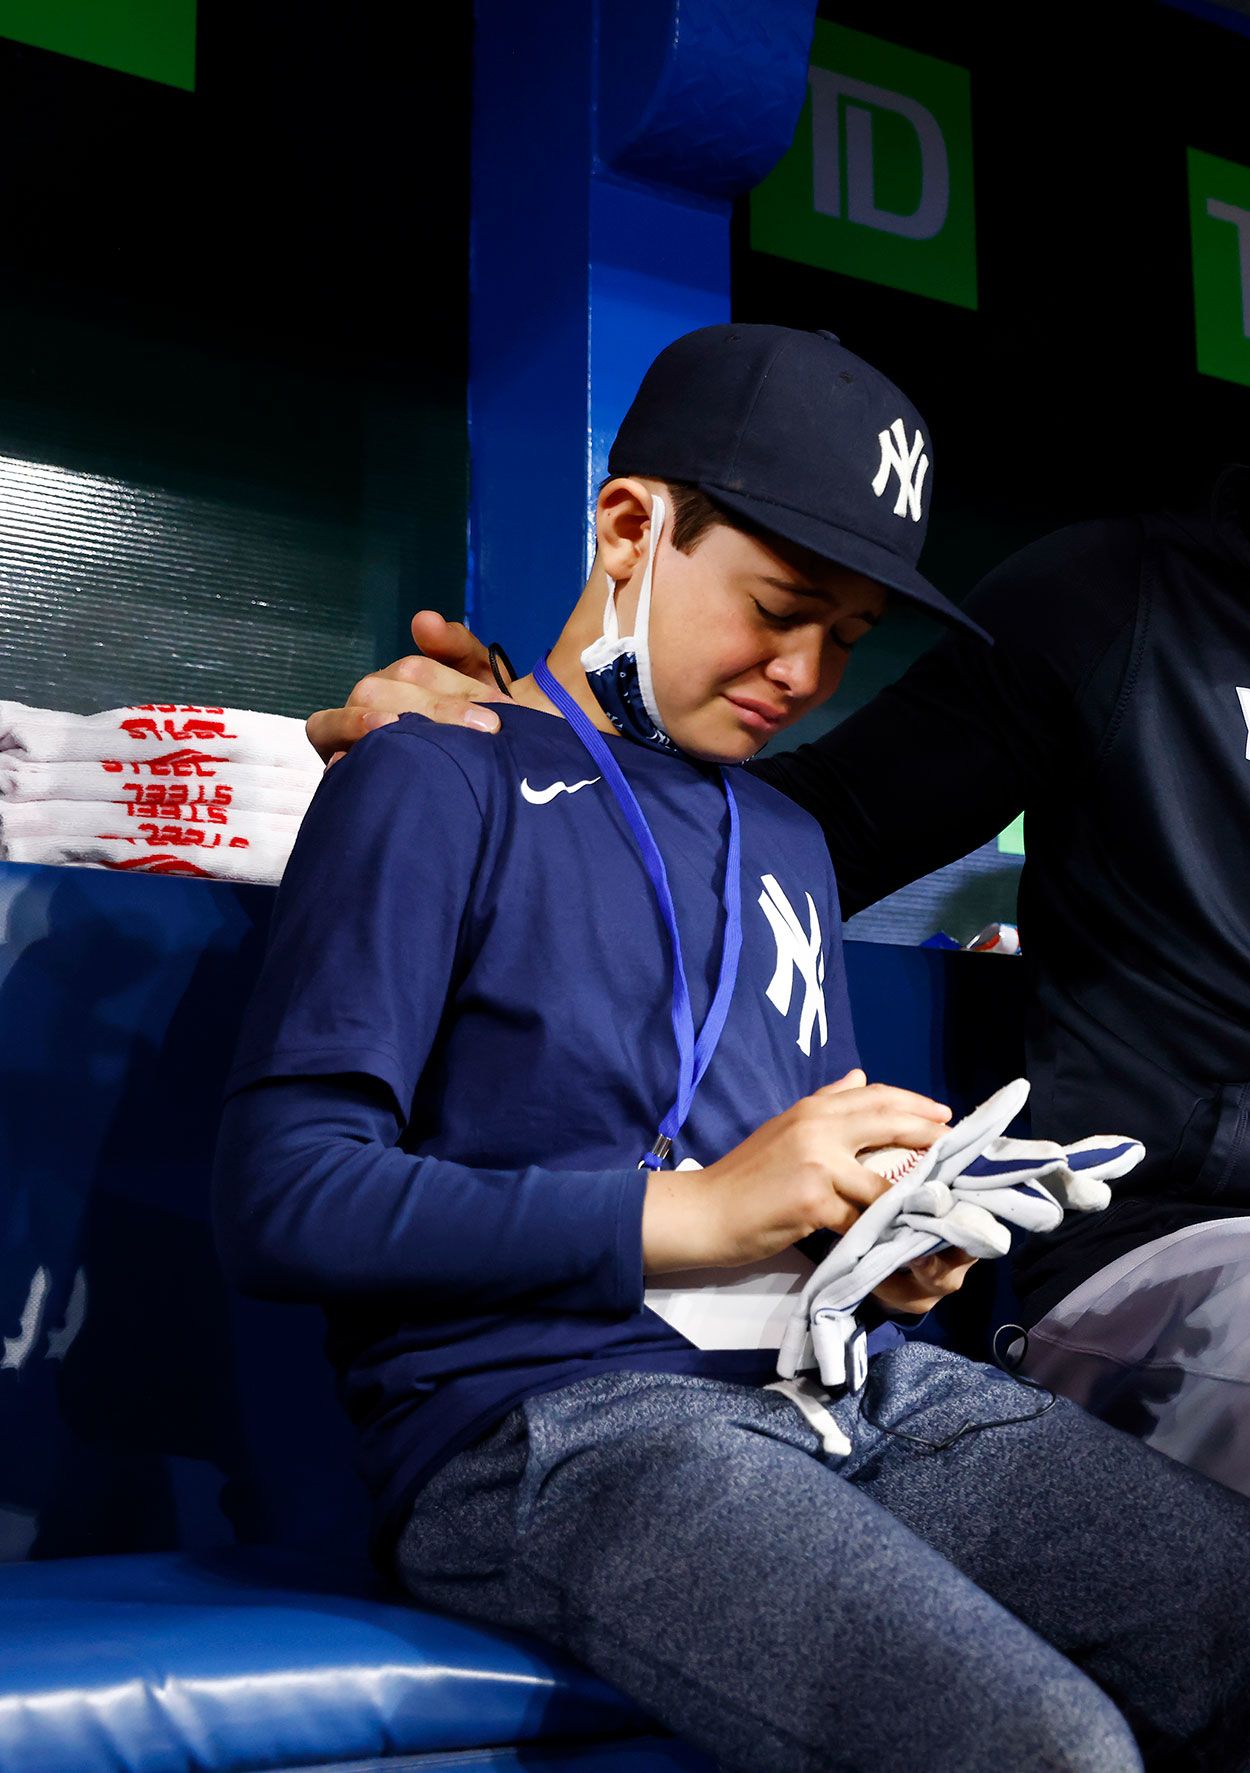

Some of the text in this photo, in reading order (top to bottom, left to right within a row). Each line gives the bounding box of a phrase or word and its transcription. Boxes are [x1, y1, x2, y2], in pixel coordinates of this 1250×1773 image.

[806, 63, 950, 241] TD
[871, 418, 929, 522] NY
[123, 784, 233, 804] STEEL
[757, 873, 828, 1057] NY
